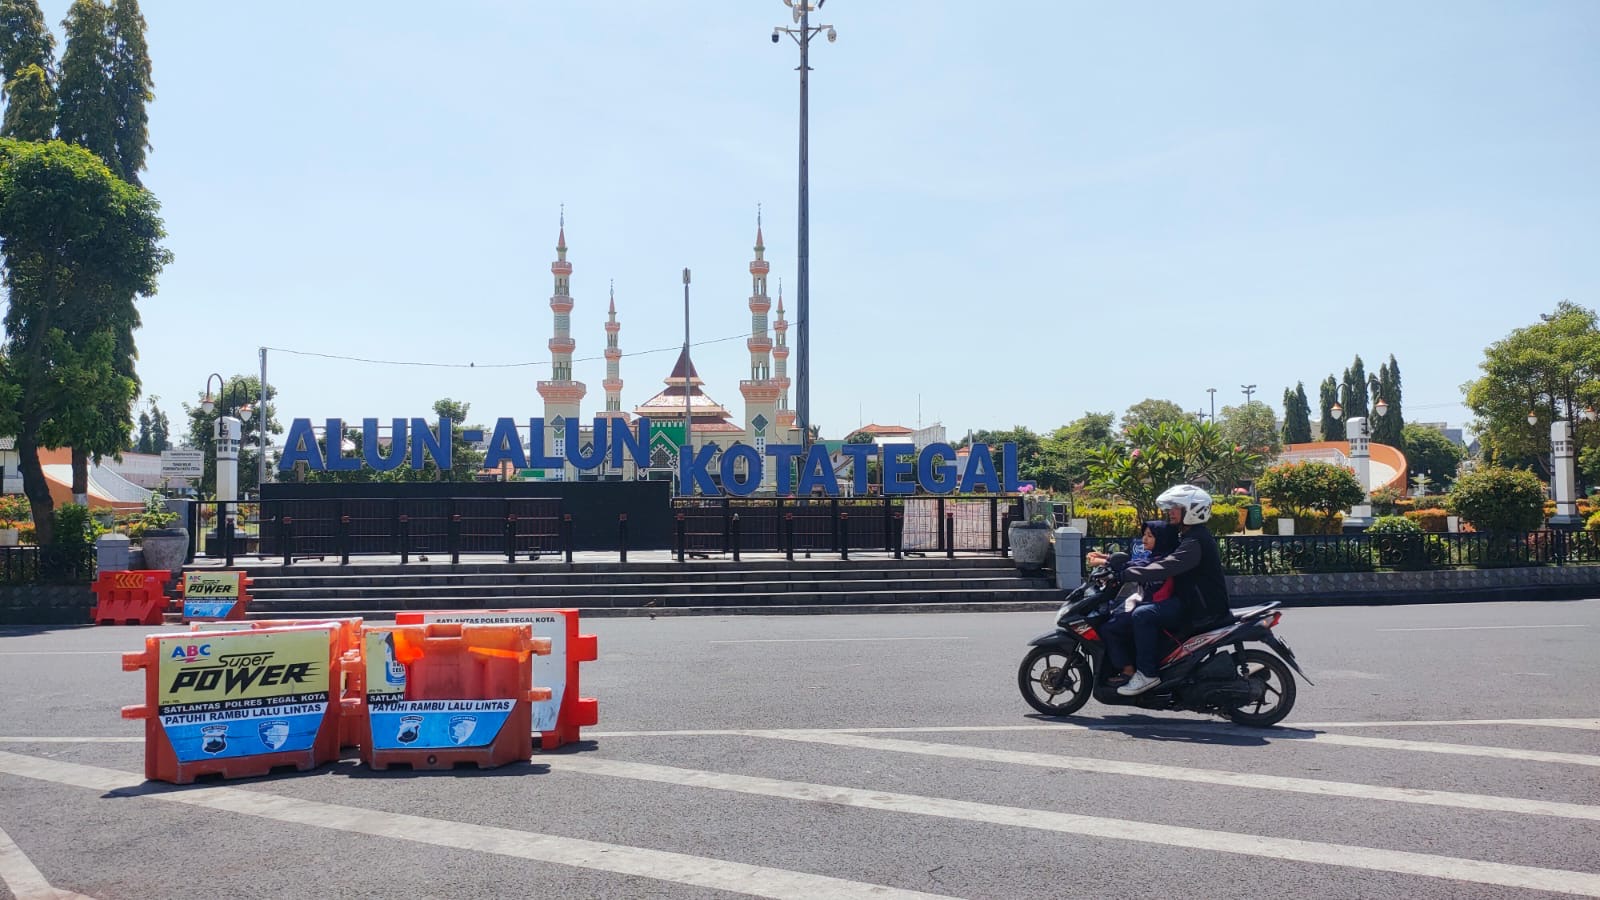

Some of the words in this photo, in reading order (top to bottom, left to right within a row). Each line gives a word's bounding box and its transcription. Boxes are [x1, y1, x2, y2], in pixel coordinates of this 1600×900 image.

[188, 584, 232, 594] POWER
[171, 644, 211, 658] ABC
[218, 651, 276, 668] Super
[169, 662, 317, 695] POWER
[163, 702, 221, 714] SATLANTAS
[225, 699, 263, 709] POLRES
[267, 696, 297, 705] TEGAL
[301, 693, 326, 702] KOTA
[372, 702, 408, 711] PATUHI
[410, 702, 445, 711] RAMBU
[447, 702, 472, 711] LALU
[475, 701, 510, 710] LINTAS
[165, 714, 206, 725] PATUHI
[209, 711, 250, 721] RAMBU
[253, 708, 280, 717] LALU
[283, 704, 322, 714] LINTAS
